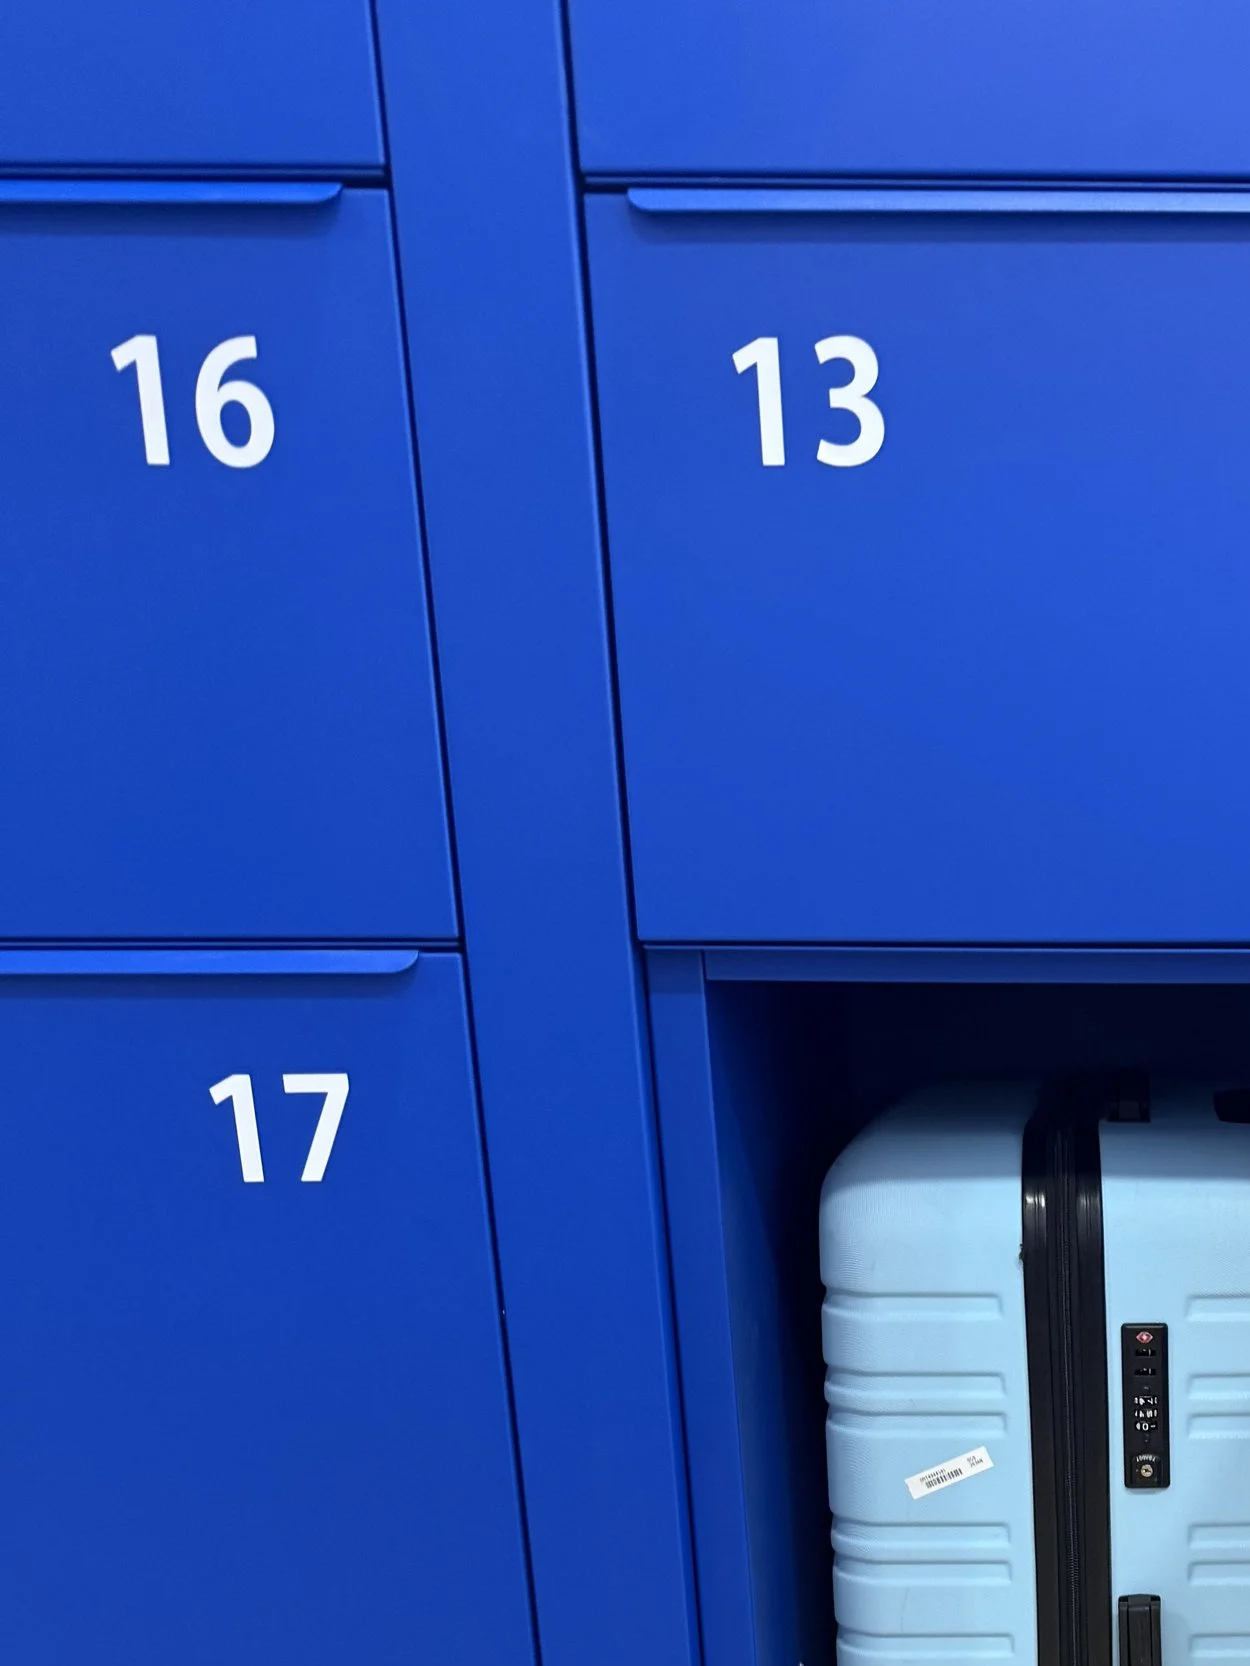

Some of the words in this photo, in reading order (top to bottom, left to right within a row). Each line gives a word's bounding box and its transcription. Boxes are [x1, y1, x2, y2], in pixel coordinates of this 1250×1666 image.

[110, 335, 275, 468] 16
[732, 335, 885, 467] 13
[209, 1073, 350, 1183] 17
